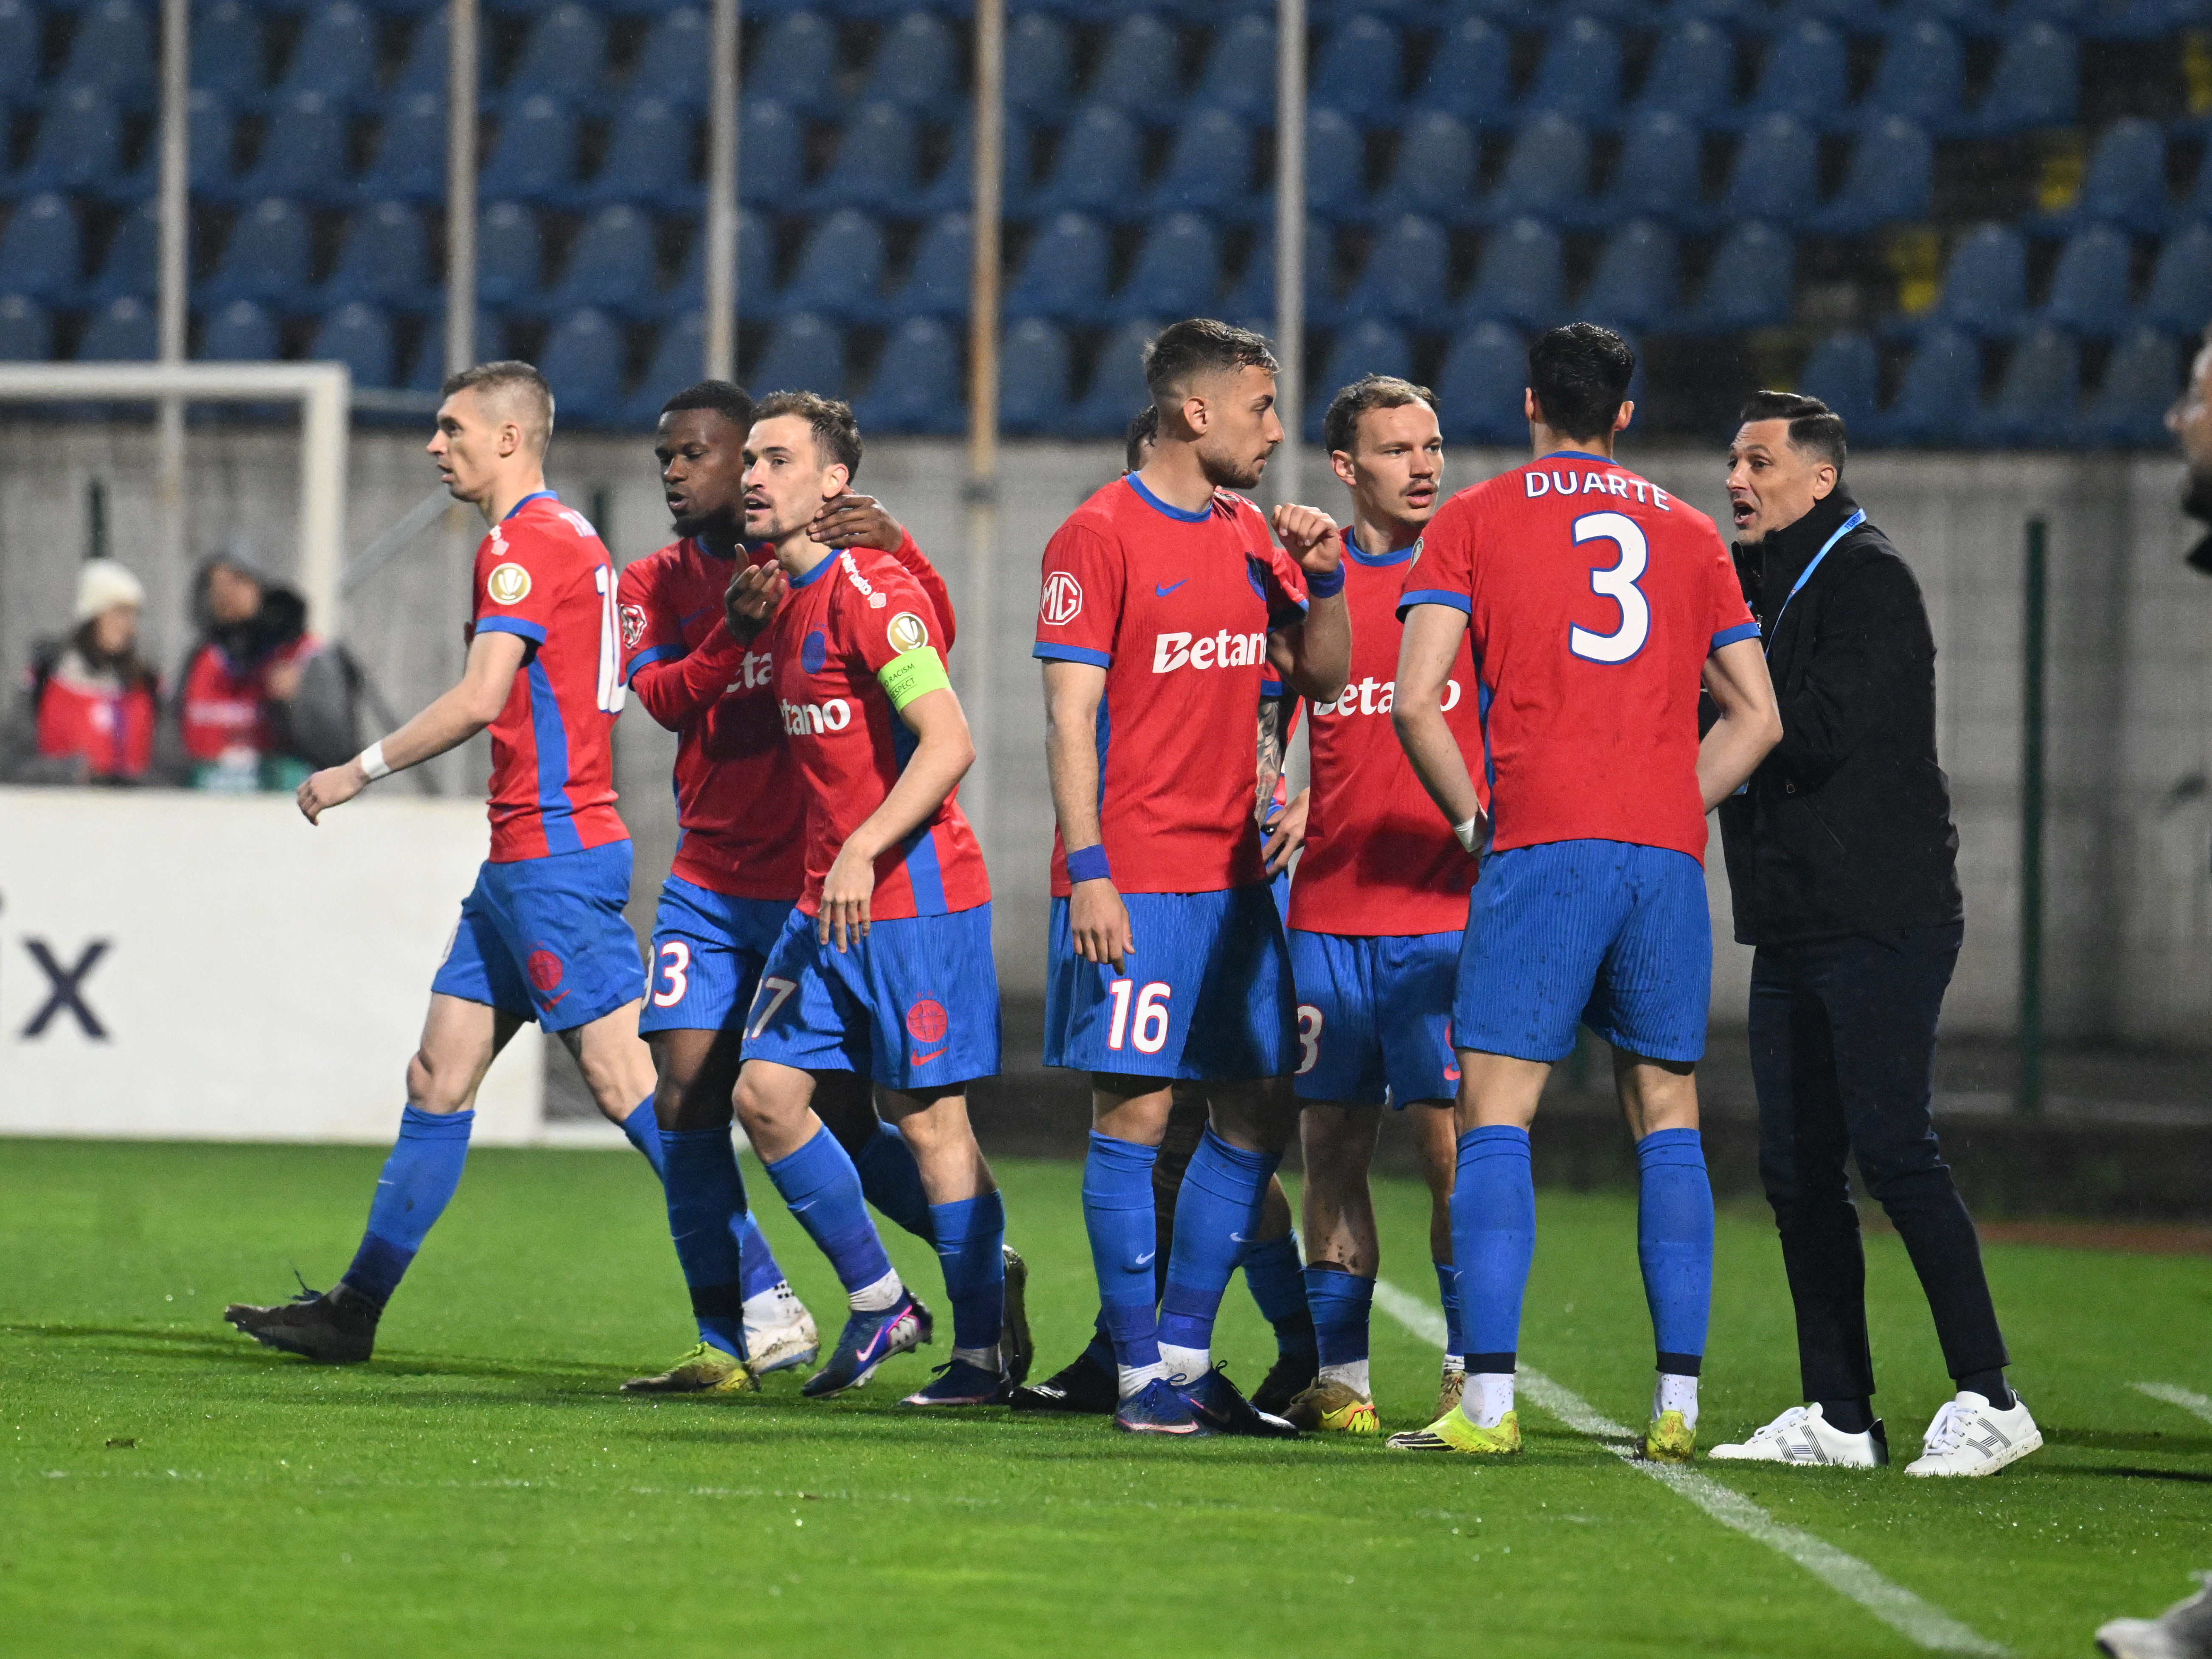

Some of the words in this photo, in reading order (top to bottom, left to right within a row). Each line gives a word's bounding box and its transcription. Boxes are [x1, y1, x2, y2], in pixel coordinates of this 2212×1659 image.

[1524, 471, 1670, 512] DUARTE
[1041, 576, 1078, 620] MG
[1569, 510, 1651, 665] 3
[889, 663, 915, 682] RACISM
[1152, 629, 1266, 673] Betan
[780, 698, 851, 735] tano
[1313, 677, 1461, 716] etao
[742, 975, 800, 1039] 7
[1108, 978, 1171, 1055] 16
